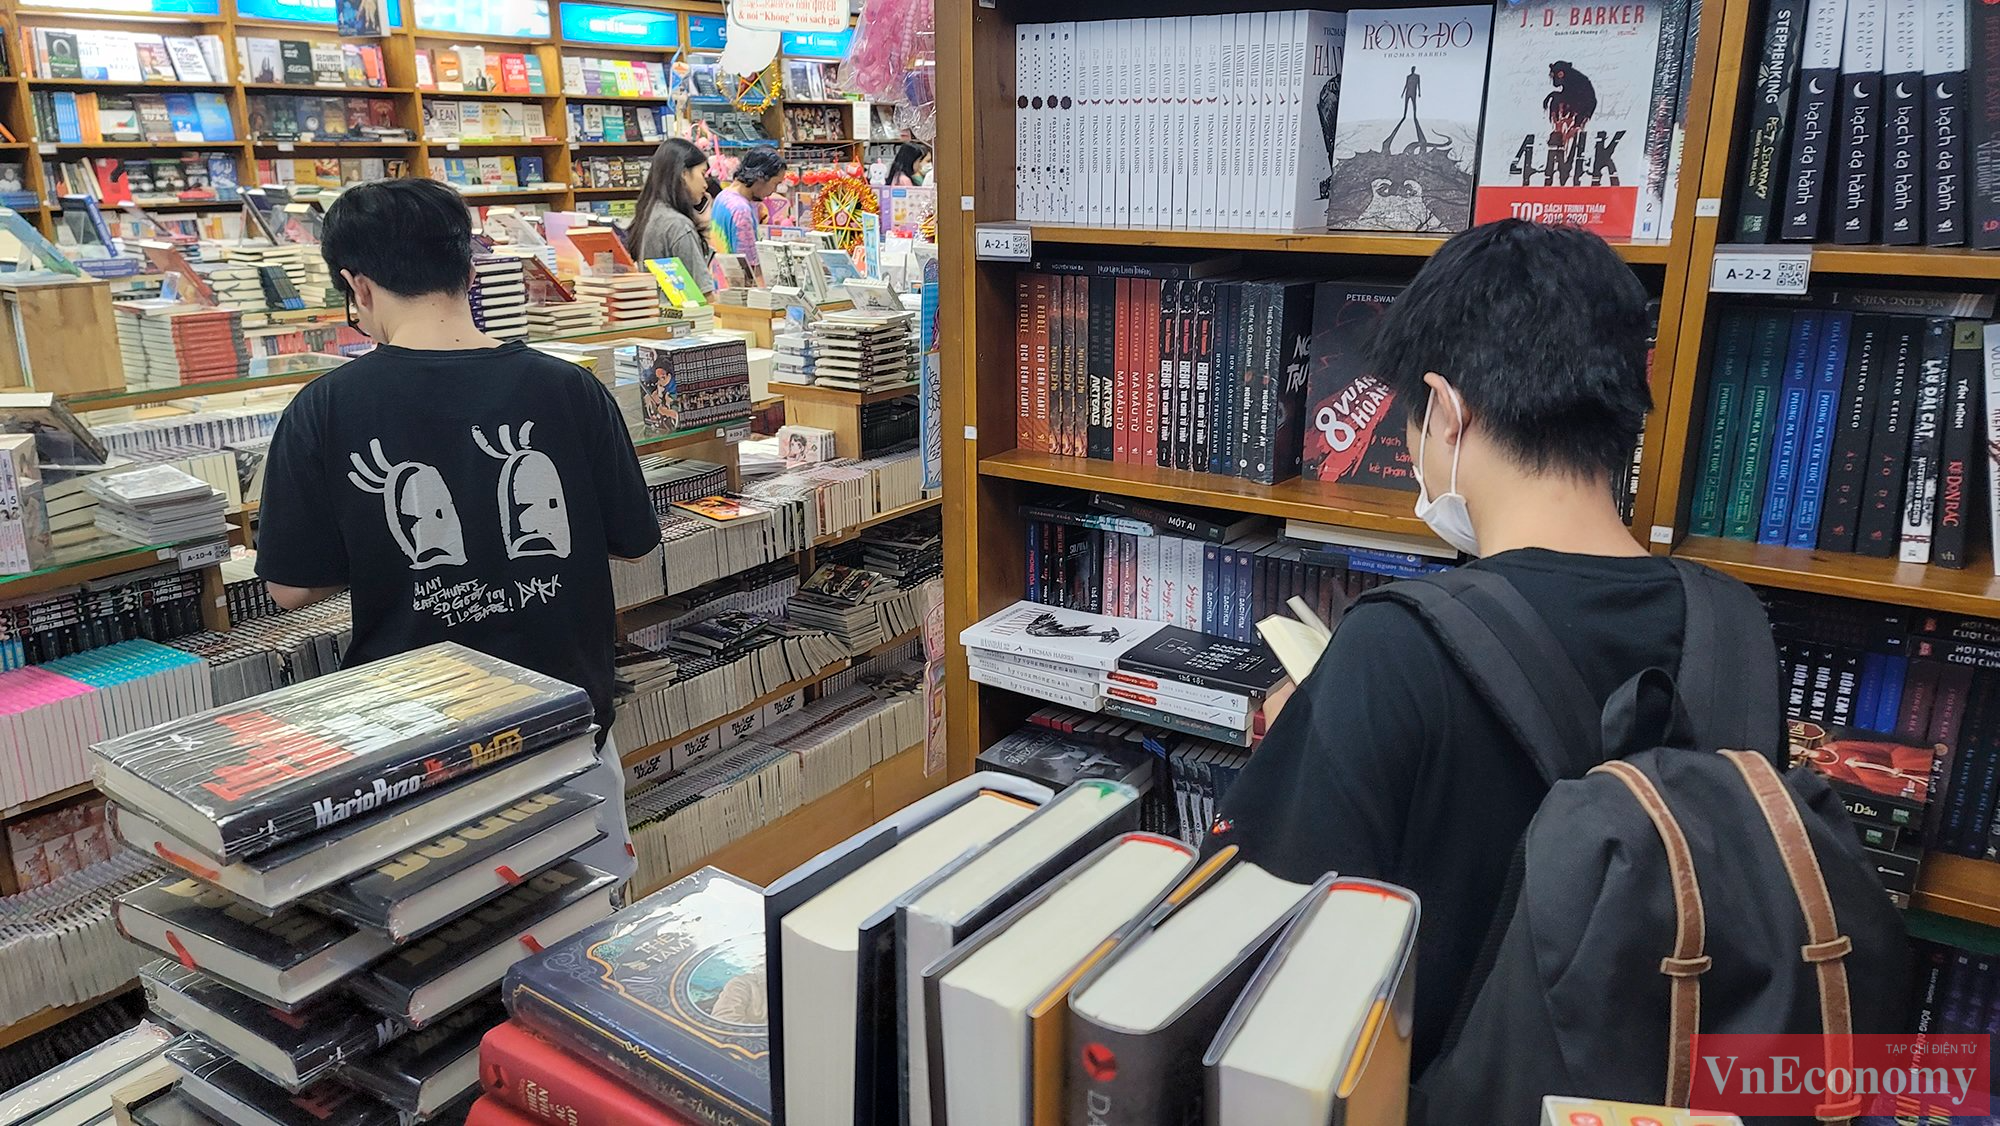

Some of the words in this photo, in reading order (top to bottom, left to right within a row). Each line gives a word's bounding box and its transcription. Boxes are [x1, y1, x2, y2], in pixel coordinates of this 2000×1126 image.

[1520, 8, 1534, 28] J.
[1543, 8, 1560, 27] D.
[1570, 5, 1645, 26] BARKER
[1814, 8, 1826, 50] KEIGO
[1856, 10, 1866, 54] KEIGO
[1897, 12, 1905, 53] KEIGO
[1362, 20, 1435, 50] RỒNG
[1429, 17, 1473, 48] ĐỎ
[1822, 0, 1836, 66] IGASHINO
[1946, 0, 1954, 70] IGASHINO
[434, 108, 457, 121] LEAN
[1803, 102, 1824, 141] bạch
[1850, 107, 1869, 145] bạch
[1892, 107, 1912, 145] bạch
[1935, 107, 1955, 146] bạch
[1800, 146, 1816, 164] dạ
[1848, 150, 1863, 168] dạ
[1893, 150, 1909, 168] dạ
[1936, 151, 1953, 169] dạ
[1755, 145, 1776, 200] SEMATARY
[1795, 170, 1815, 205] hành
[1846, 174, 1864, 209] hành
[1893, 174, 1910, 210] hành
[1937, 175, 1955, 211] hành
[1510, 202, 1543, 222] TOP
[984, 240, 1010, 249] A-2-1
[1726, 268, 1772, 280] A-2-2
[1346, 294, 1371, 302] PETER
[1374, 295, 1398, 303] SWAN
[1161, 360, 1172, 388] EREBOS
[1179, 361, 1191, 389] EREBOS
[1196, 362, 1208, 391] EREBOS
[1857, 331, 1873, 392] HIGASHINO
[1893, 335, 1909, 395] HIGASHINO
[1020, 387, 1029, 417] ATLANTIS
[1037, 387, 1045, 419] ATLANTIS
[1090, 374, 1100, 426] ARTEMIS
[1102, 376, 1112, 428] ARTEMIS
[1852, 397, 1864, 428] KEIGO
[1888, 400, 1900, 432] KEIGO
[1314, 406, 1356, 452] 8
[1168, 516, 1186, 529] MỘT
[1187, 521, 1196, 531] AI
[187, 550, 212, 562] A-10-4
[432, 602, 450, 616] SO
[452, 584, 488, 609] GOOD
[486, 588, 506, 603] YOU
[442, 614, 456, 627] I
[456, 602, 484, 623] LOVE
[1028, 648, 1049, 658] THOMAS
[1050, 652, 1074, 661] HARRIS
[1789, 688, 1805, 705] EM
[1811, 691, 1827, 708] EM
[1835, 696, 1850, 714] EM
